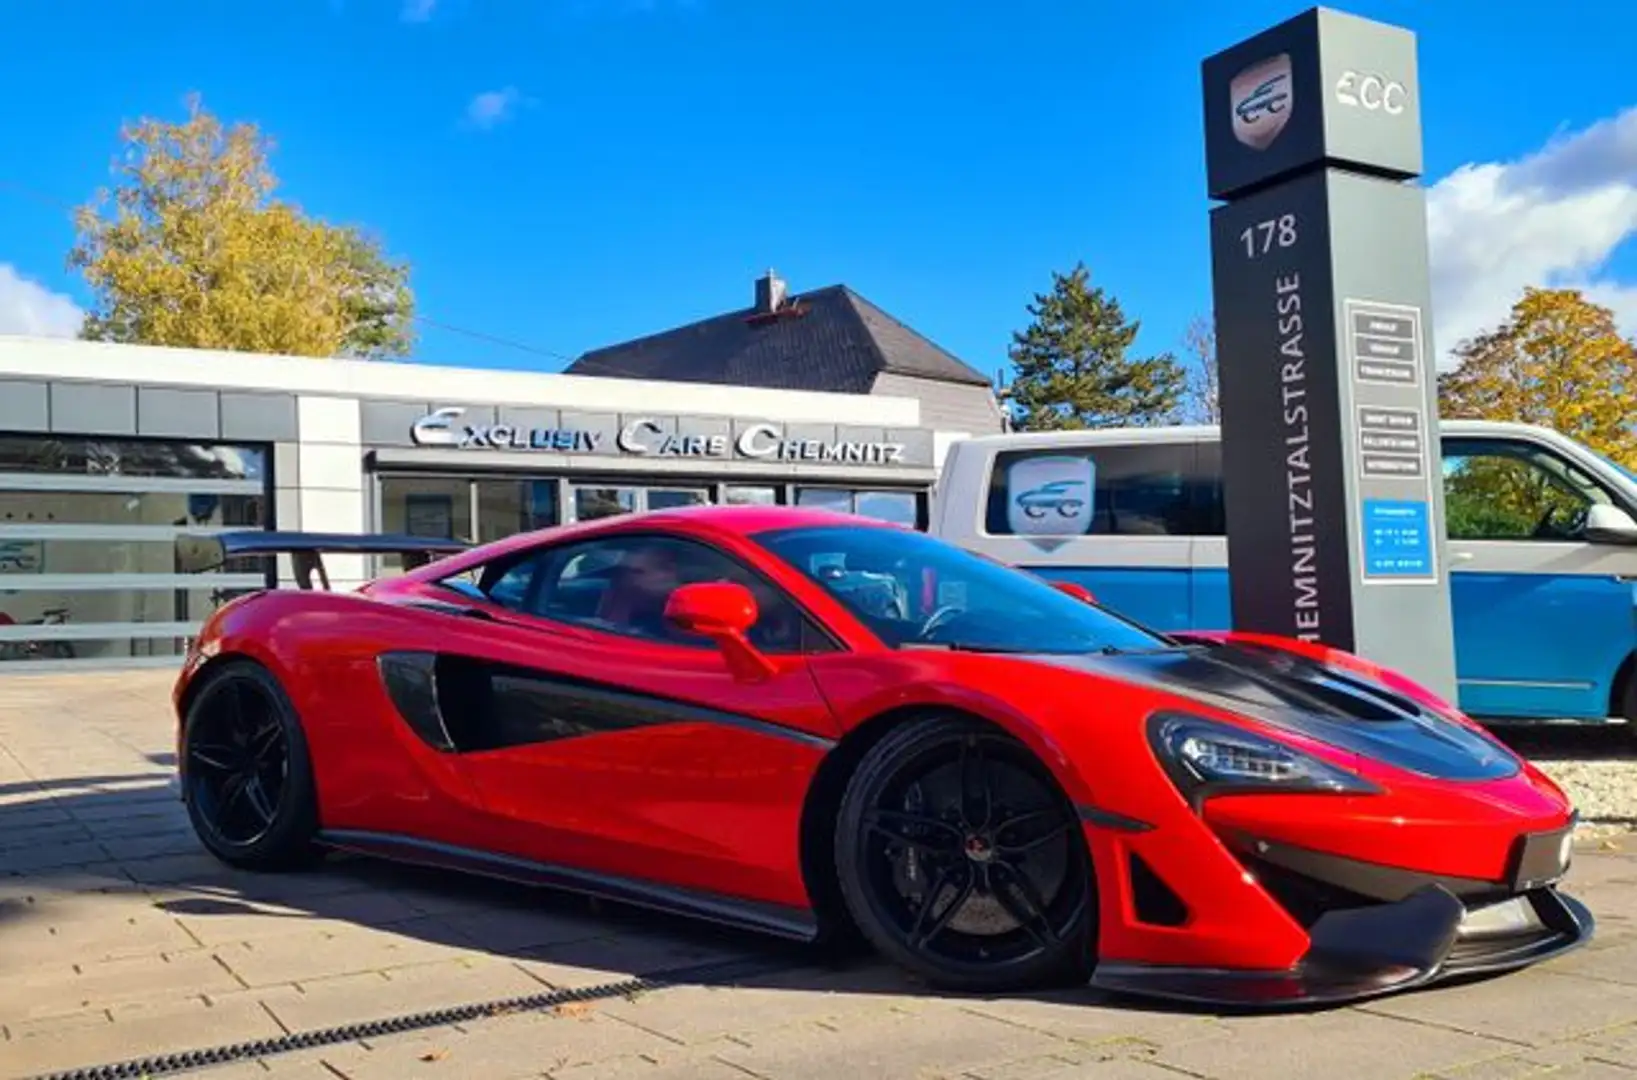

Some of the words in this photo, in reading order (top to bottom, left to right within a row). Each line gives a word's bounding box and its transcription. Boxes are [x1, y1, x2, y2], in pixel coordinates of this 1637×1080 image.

[1336, 71, 1406, 114] ECC
[1240, 214, 1297, 258] 178
[1277, 272, 1320, 642] EMNITZTALSTRASSE
